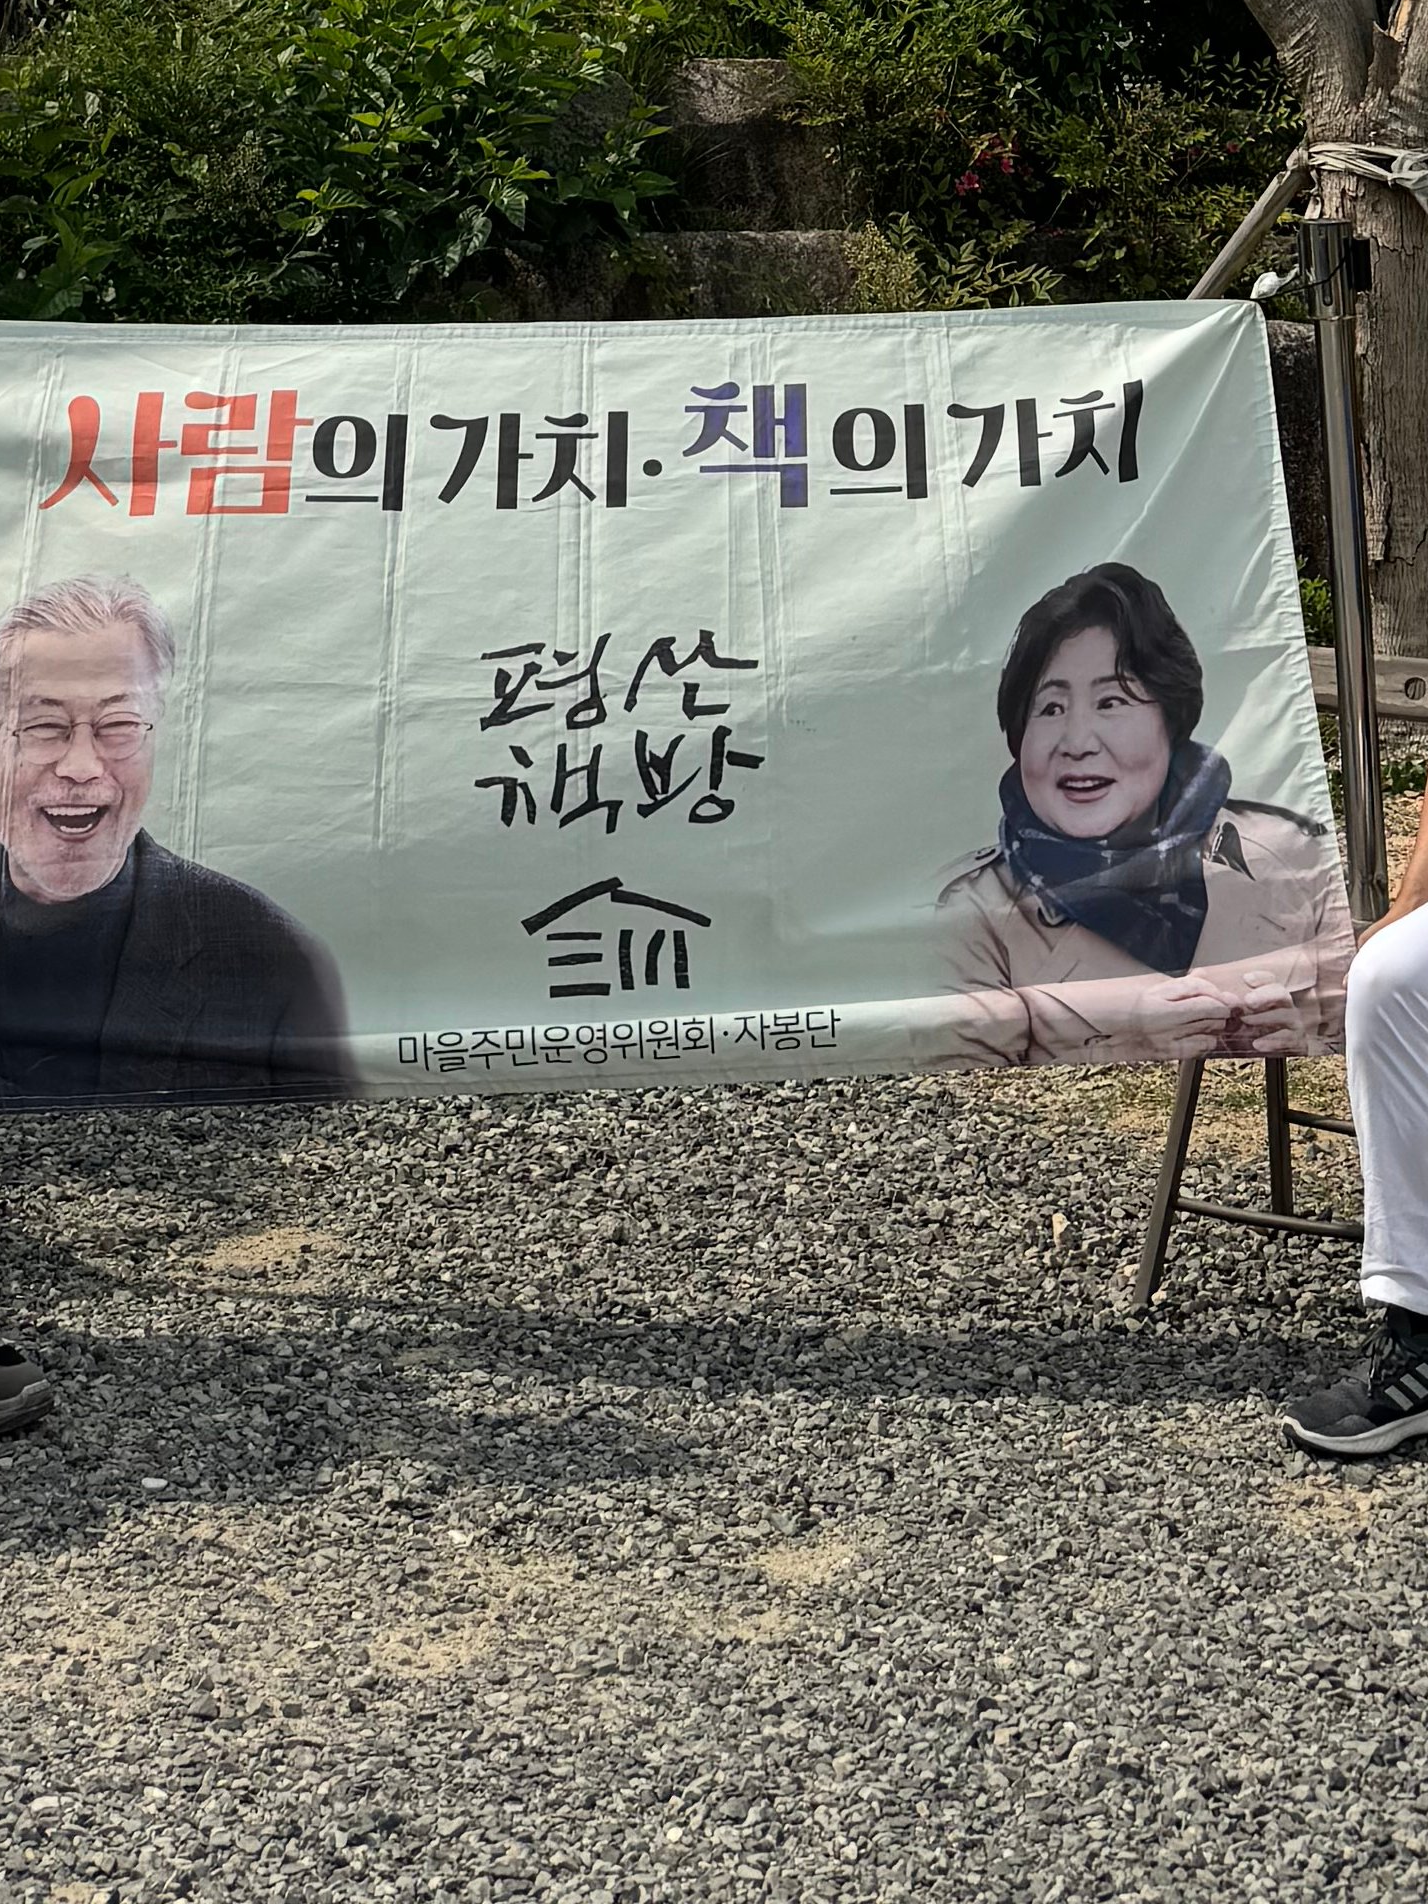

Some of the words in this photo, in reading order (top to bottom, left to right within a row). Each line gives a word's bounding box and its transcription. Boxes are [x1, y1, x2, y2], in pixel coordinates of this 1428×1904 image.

[39, 389, 409, 516] 사람의
[946, 379, 1144, 488] 가치
[480, 629, 759, 731] 평산
[474, 725, 765, 834] 책방
